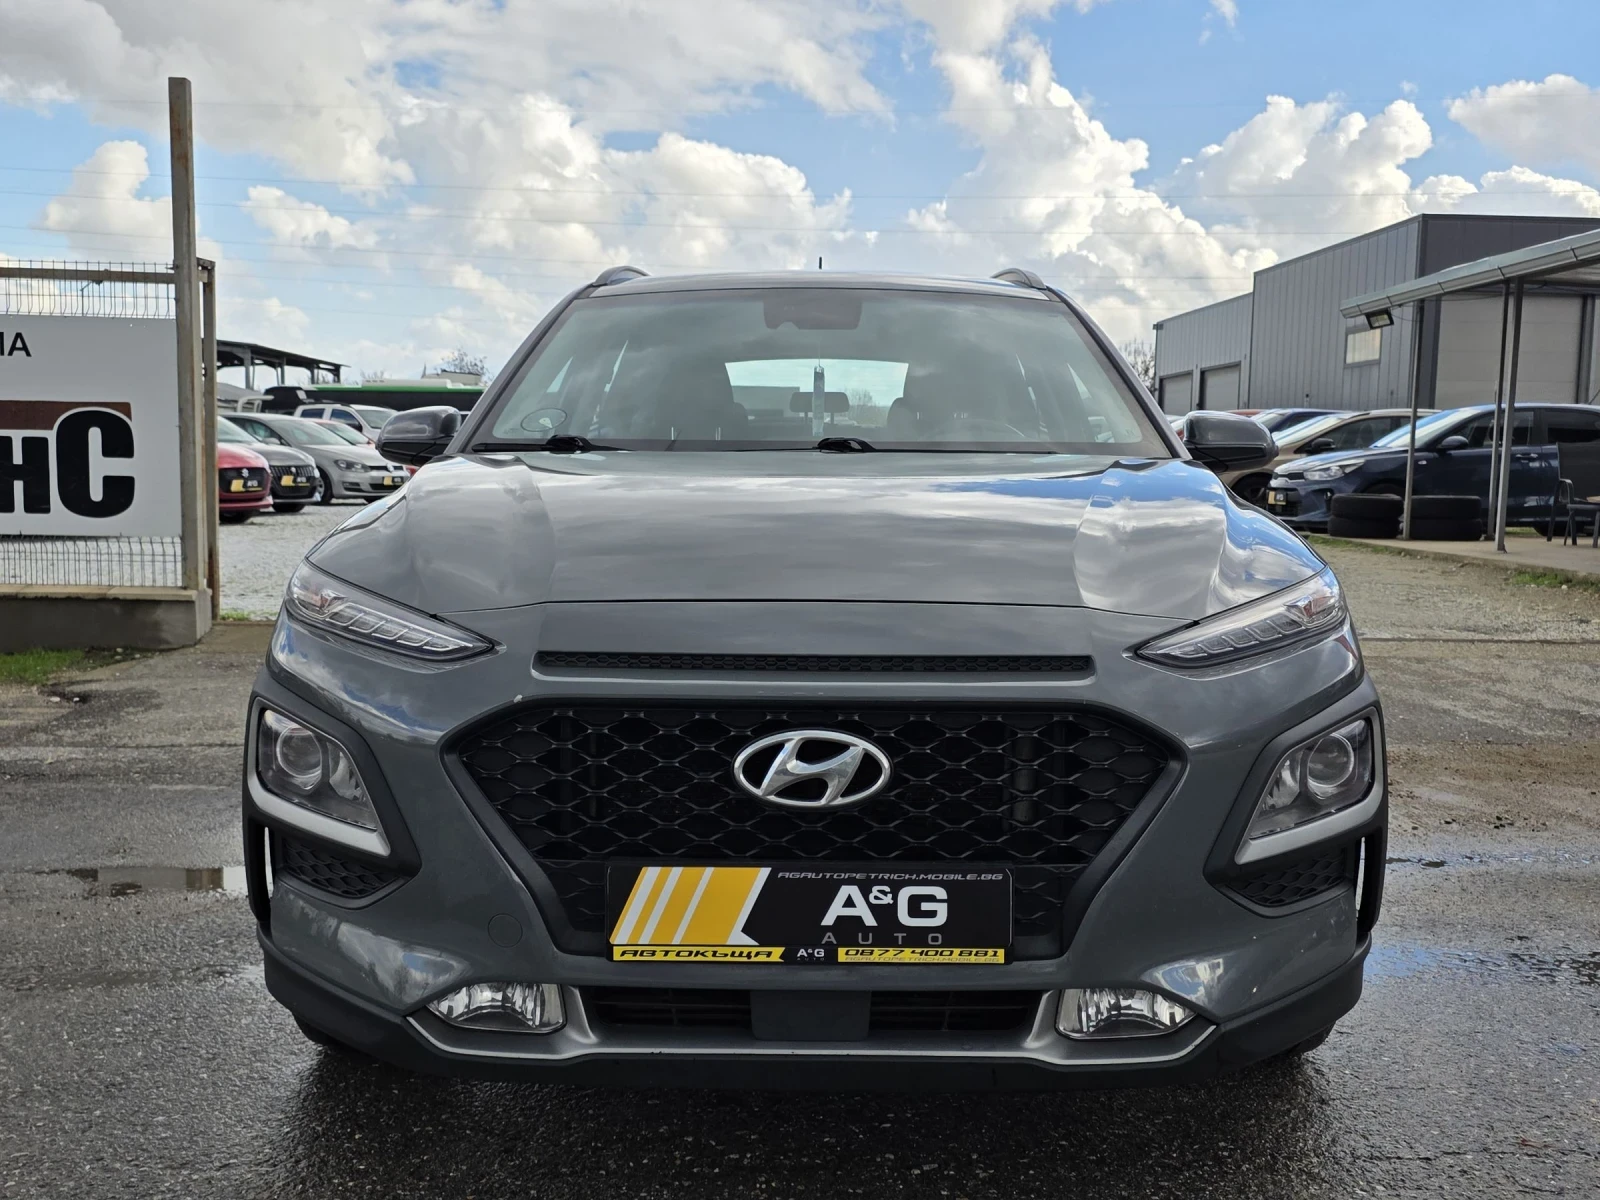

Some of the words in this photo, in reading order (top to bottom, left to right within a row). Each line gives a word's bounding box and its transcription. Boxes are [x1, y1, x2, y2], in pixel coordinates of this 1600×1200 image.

[777, 871, 1004, 881] AGAUTOPETRICH.MOBILE.BG
[820, 884, 948, 927] A&G
[821, 931, 943, 945] AUTO
[619, 949, 773, 960] АВТОКЪЩА
[844, 948, 905, 957] 0877
[910, 949, 954, 957] 400
[957, 949, 1000, 958] 881
